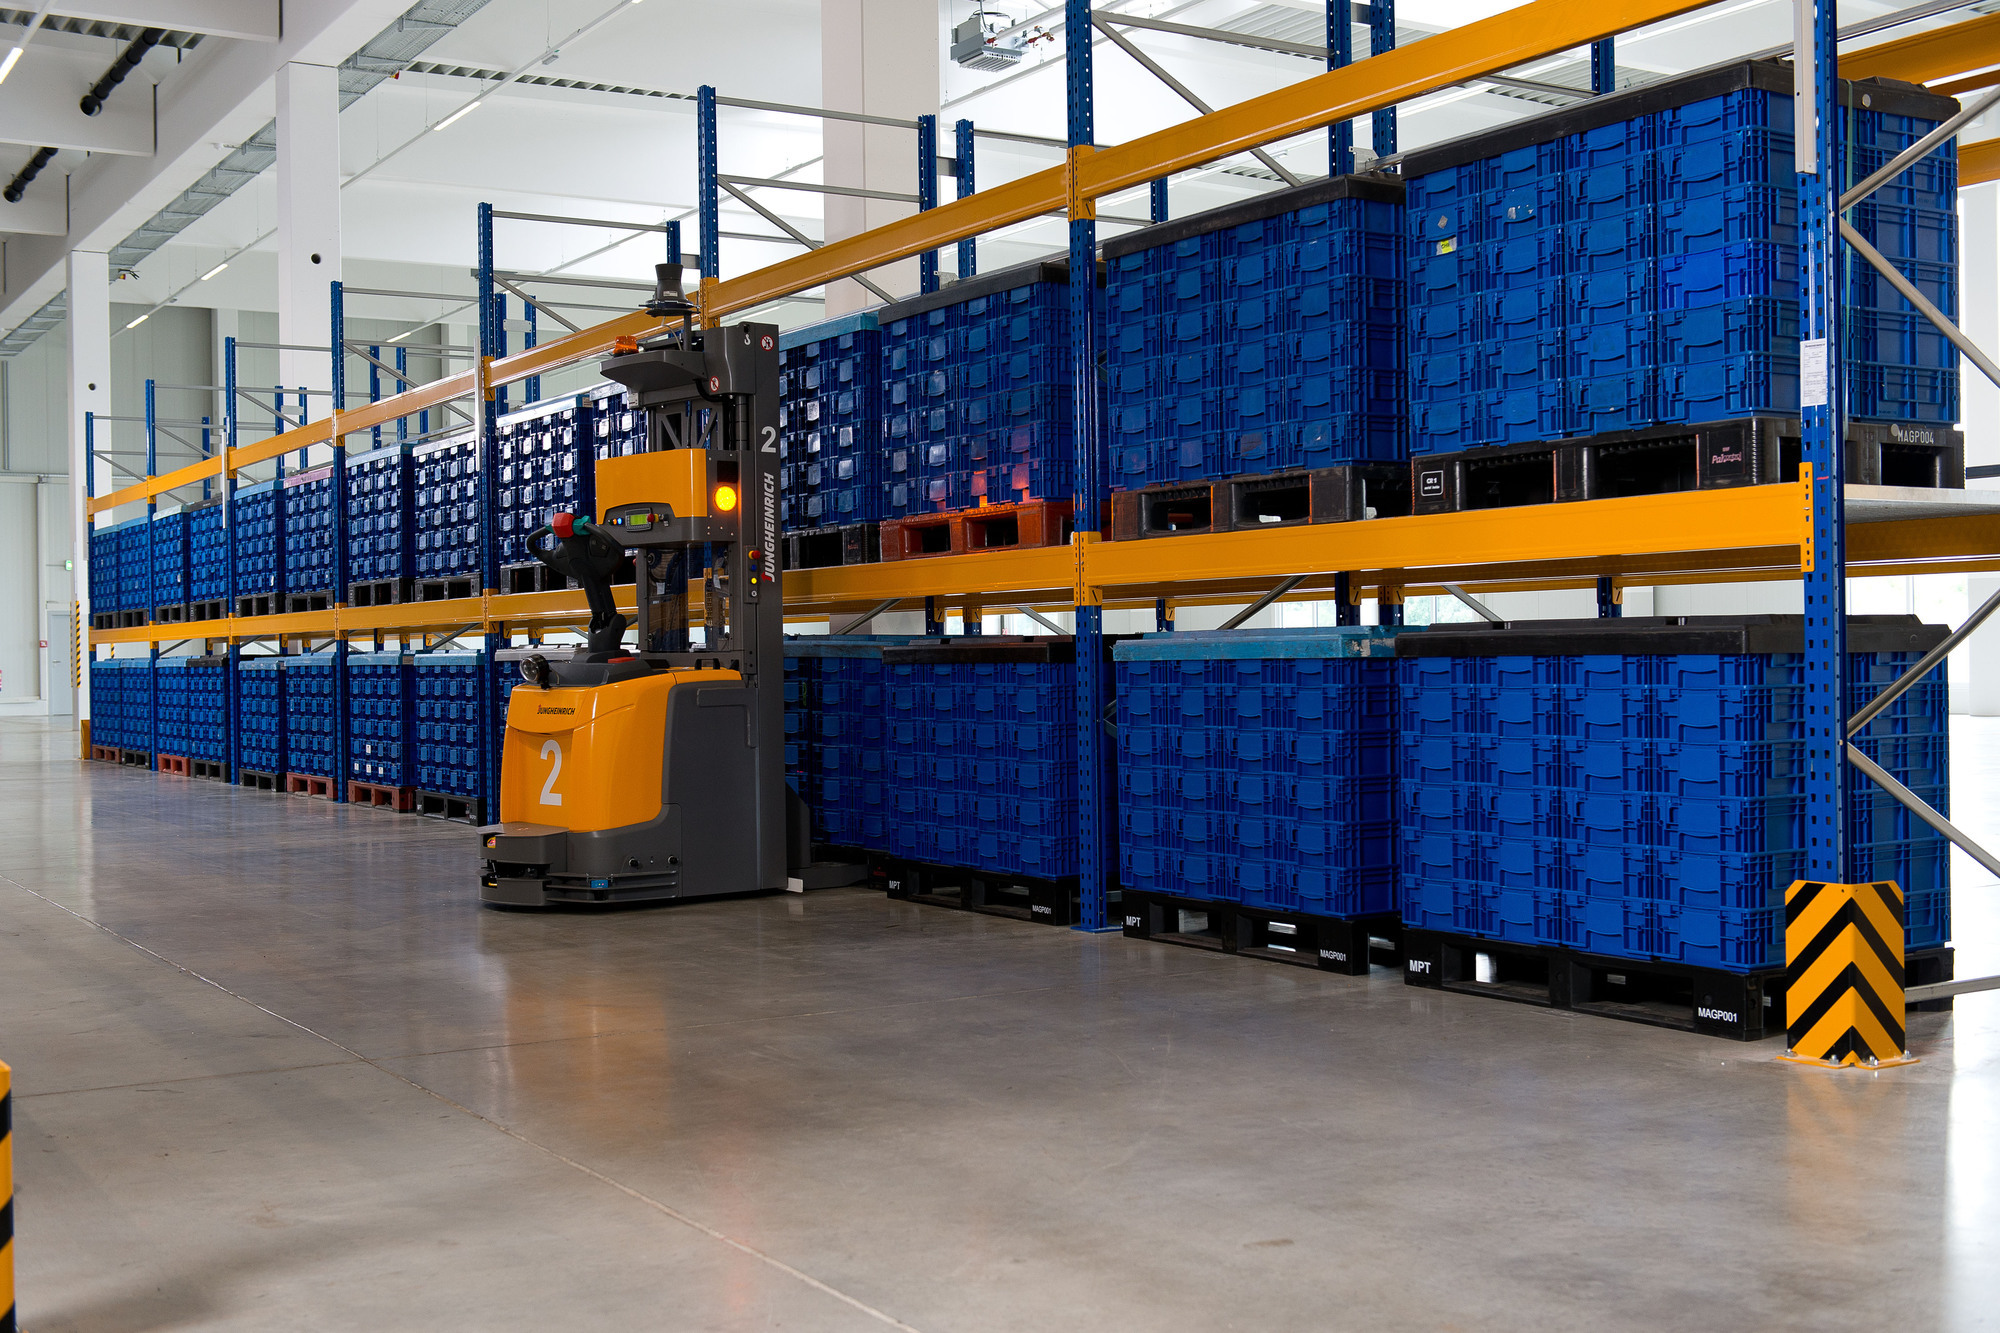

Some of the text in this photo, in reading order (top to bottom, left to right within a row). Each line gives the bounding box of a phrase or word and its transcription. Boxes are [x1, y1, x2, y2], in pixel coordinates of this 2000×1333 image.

[760, 426, 777, 453] 2
[1897, 430, 1934, 444] MAGP004
[761, 472, 776, 583] JUNGHEINRICH
[537, 705, 575, 715] JUNGHEINRICH
[540, 740, 562, 806] 2
[889, 880, 900, 890] MPT
[1032, 905, 1051, 914] MAGP001
[1126, 916, 1141, 928] MPT
[1320, 949, 1347, 961] MAGP001
[1409, 959, 1431, 974] MPT
[1698, 1007, 1738, 1023] MAGP001
